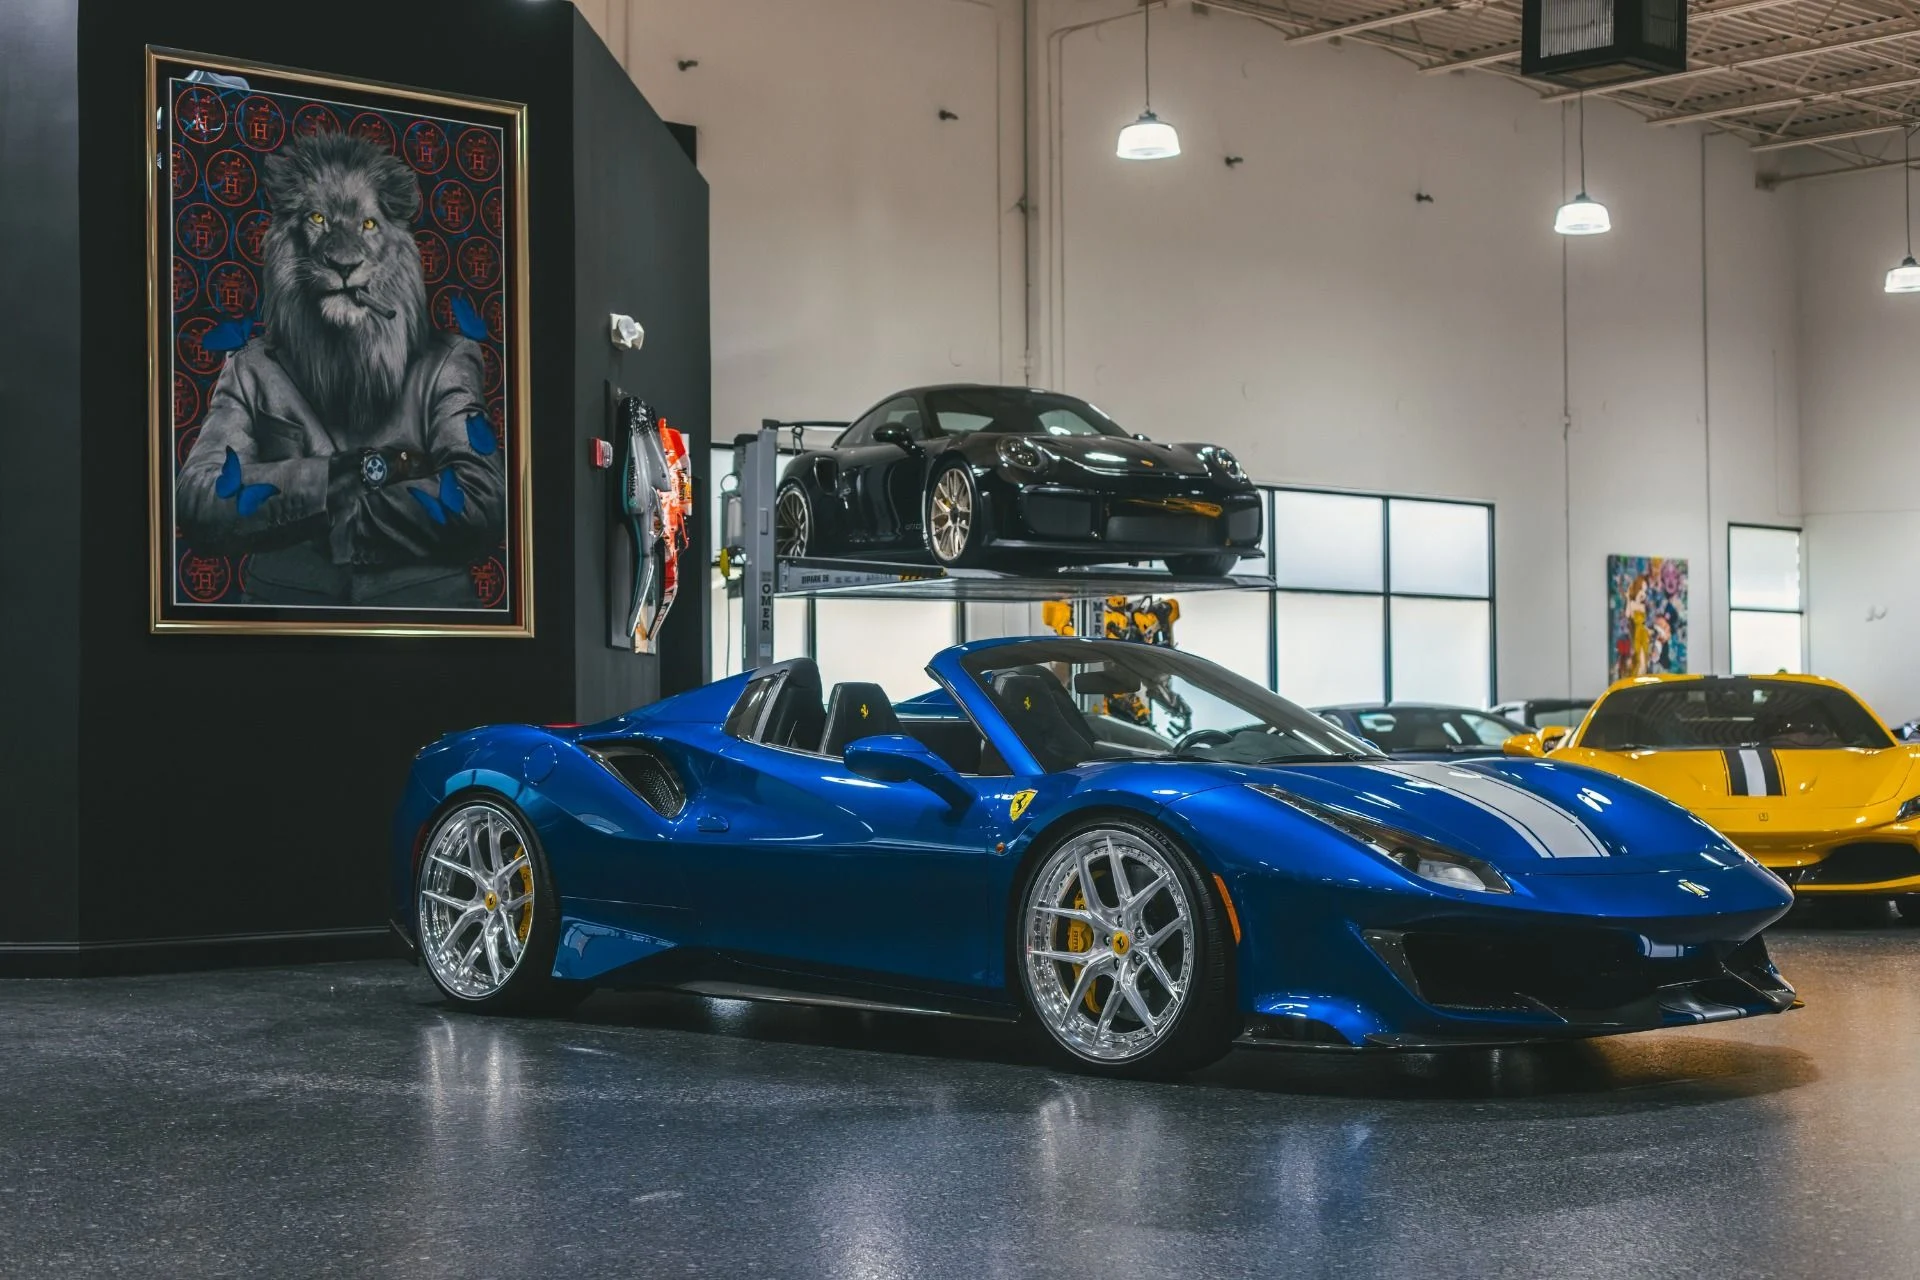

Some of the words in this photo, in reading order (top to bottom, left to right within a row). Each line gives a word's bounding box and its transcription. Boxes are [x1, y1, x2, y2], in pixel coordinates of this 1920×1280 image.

[253, 122, 268, 140] H
[420, 146, 433, 162] H
[473, 153, 486, 171] H
[224, 177, 240, 195] H
[446, 205, 461, 222] H
[194, 230, 210, 248] H
[422, 255, 434, 273] H
[472, 262, 488, 279] H
[224, 288, 241, 306] H
[199, 572, 213, 590] H
[477, 580, 491, 597] H
[761, 583, 772, 631] OMER
[1093, 602, 1103, 635] MER
